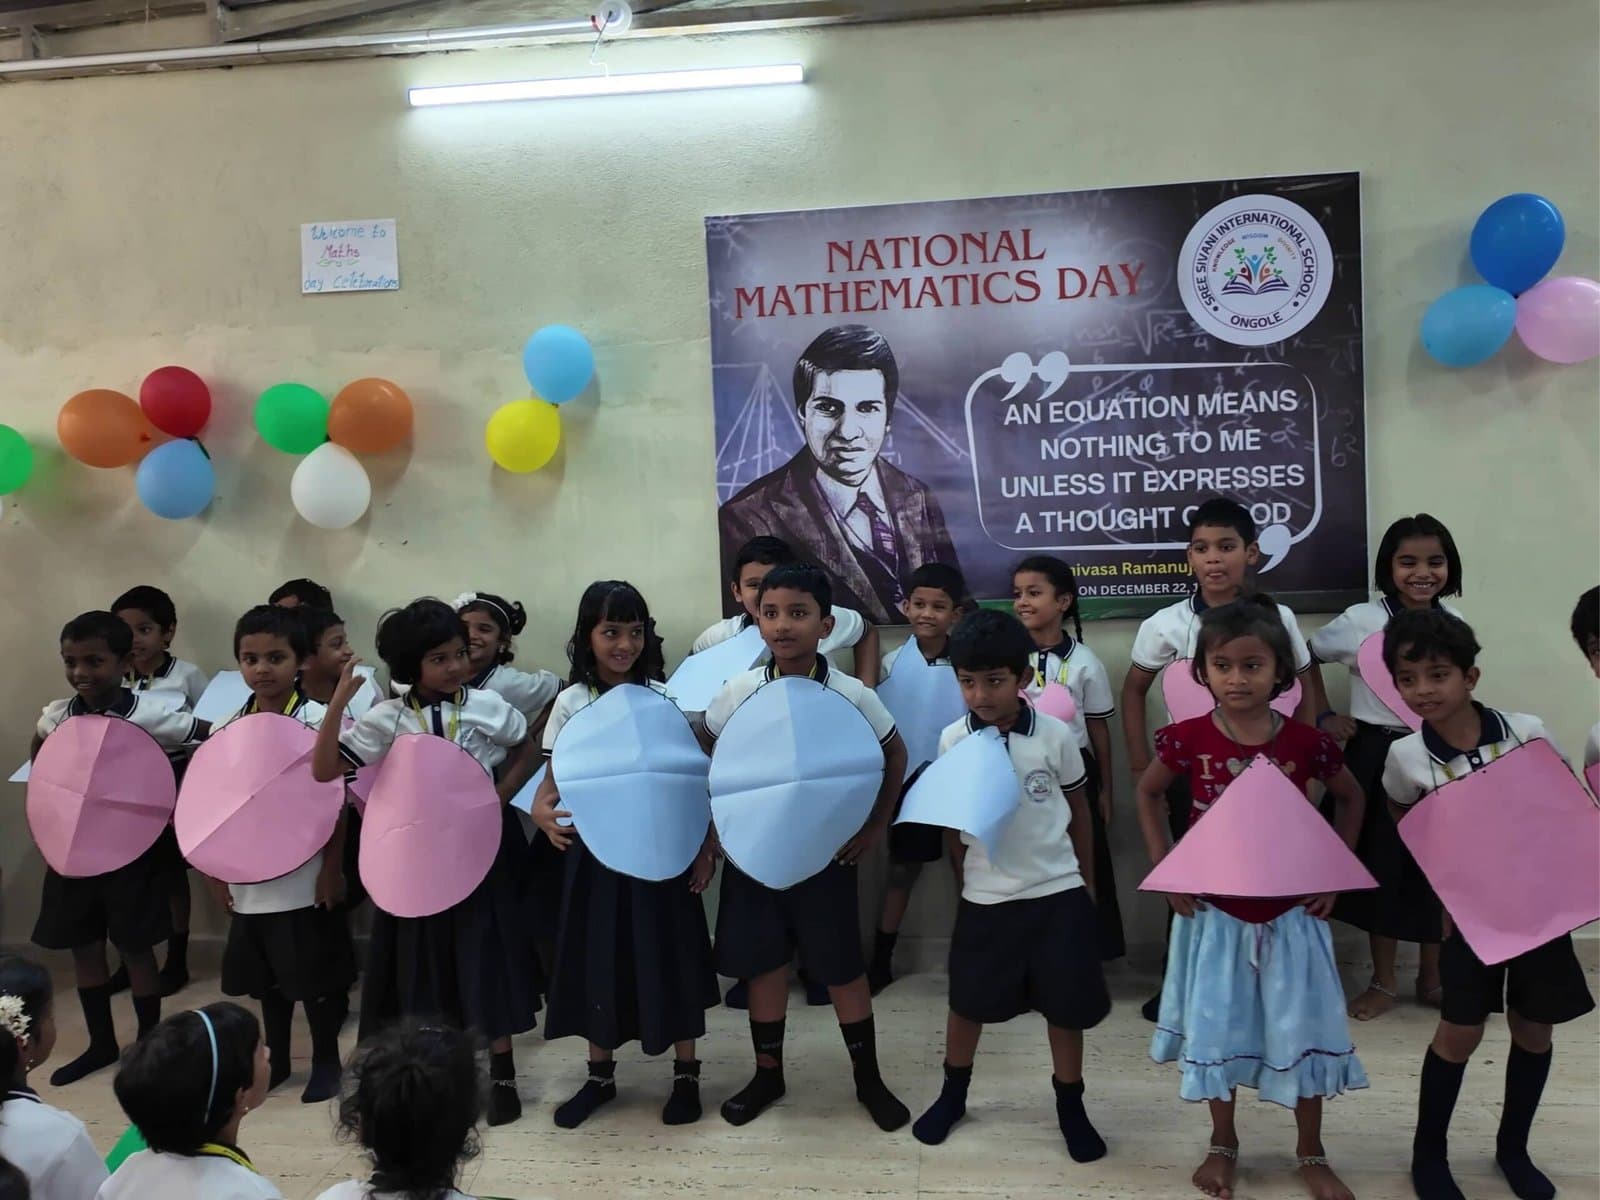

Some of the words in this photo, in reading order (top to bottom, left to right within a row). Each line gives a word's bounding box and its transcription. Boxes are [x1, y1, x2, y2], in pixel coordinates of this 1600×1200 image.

[311, 224, 364, 240] Welcome
[372, 223, 387, 239] to
[1217, 212, 1306, 249] INTERNATIONAL
[320, 243, 361, 259] Maths
[826, 228, 1047, 273] NATIONAL
[1195, 233, 1218, 273] SIVANI
[1211, 237, 1236, 273] KNOWLEDGE
[734, 270, 1042, 318] MATHEMATICS
[1056, 262, 1147, 300] DAY
[1294, 248, 1315, 299] SCHOOL
[1196, 276, 1216, 307] SREE
[1230, 311, 1284, 329] ONGOLE
[1003, 403, 1042, 426] AN
[1049, 394, 1190, 425] EQUATION
[1197, 388, 1299, 417] MEANS
[1040, 433, 1167, 461] NOTHING
[1172, 431, 1213, 454] TO
[1219, 428, 1262, 452] ME
[1001, 472, 1106, 499] UNLESS
[1112, 471, 1137, 494] IT
[1143, 464, 1306, 493] EXPRESSES
[1015, 512, 1034, 534] A
[1039, 506, 1176, 533] THOUGHT
[1240, 502, 1292, 525] OD
[1070, 563, 1118, 577] nivasa
[1122, 562, 1193, 577] Ramanuj
[1078, 586, 1098, 596] ON
[1100, 583, 1170, 596] DECEMBER
[1172, 583, 1190, 595] 22,
